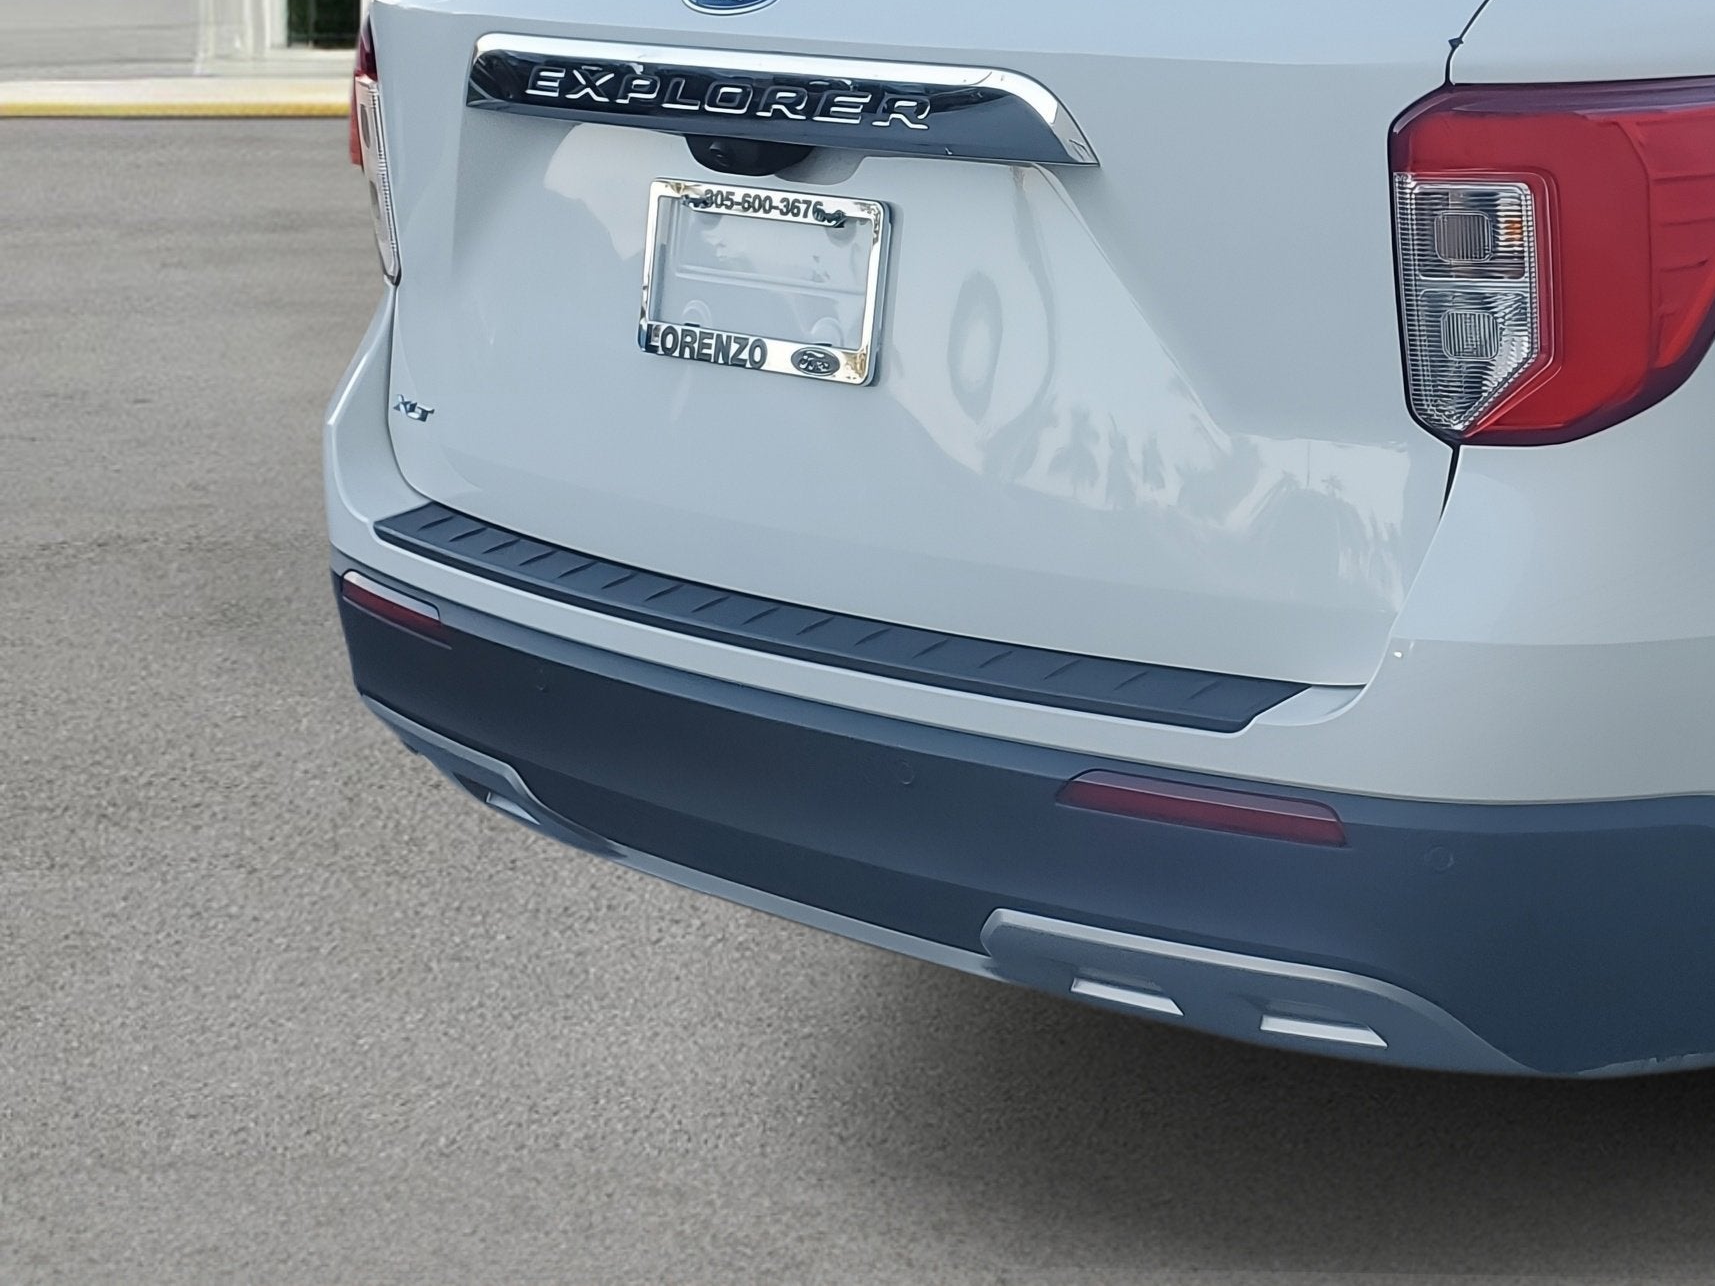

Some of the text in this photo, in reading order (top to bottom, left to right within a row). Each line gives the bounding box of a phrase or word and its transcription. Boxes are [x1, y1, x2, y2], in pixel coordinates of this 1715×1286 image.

[525, 65, 932, 131] EXPLORER
[704, 188, 825, 224] 305-600-3676
[645, 323, 769, 370] LORENZO
[393, 393, 436, 423] XLT
